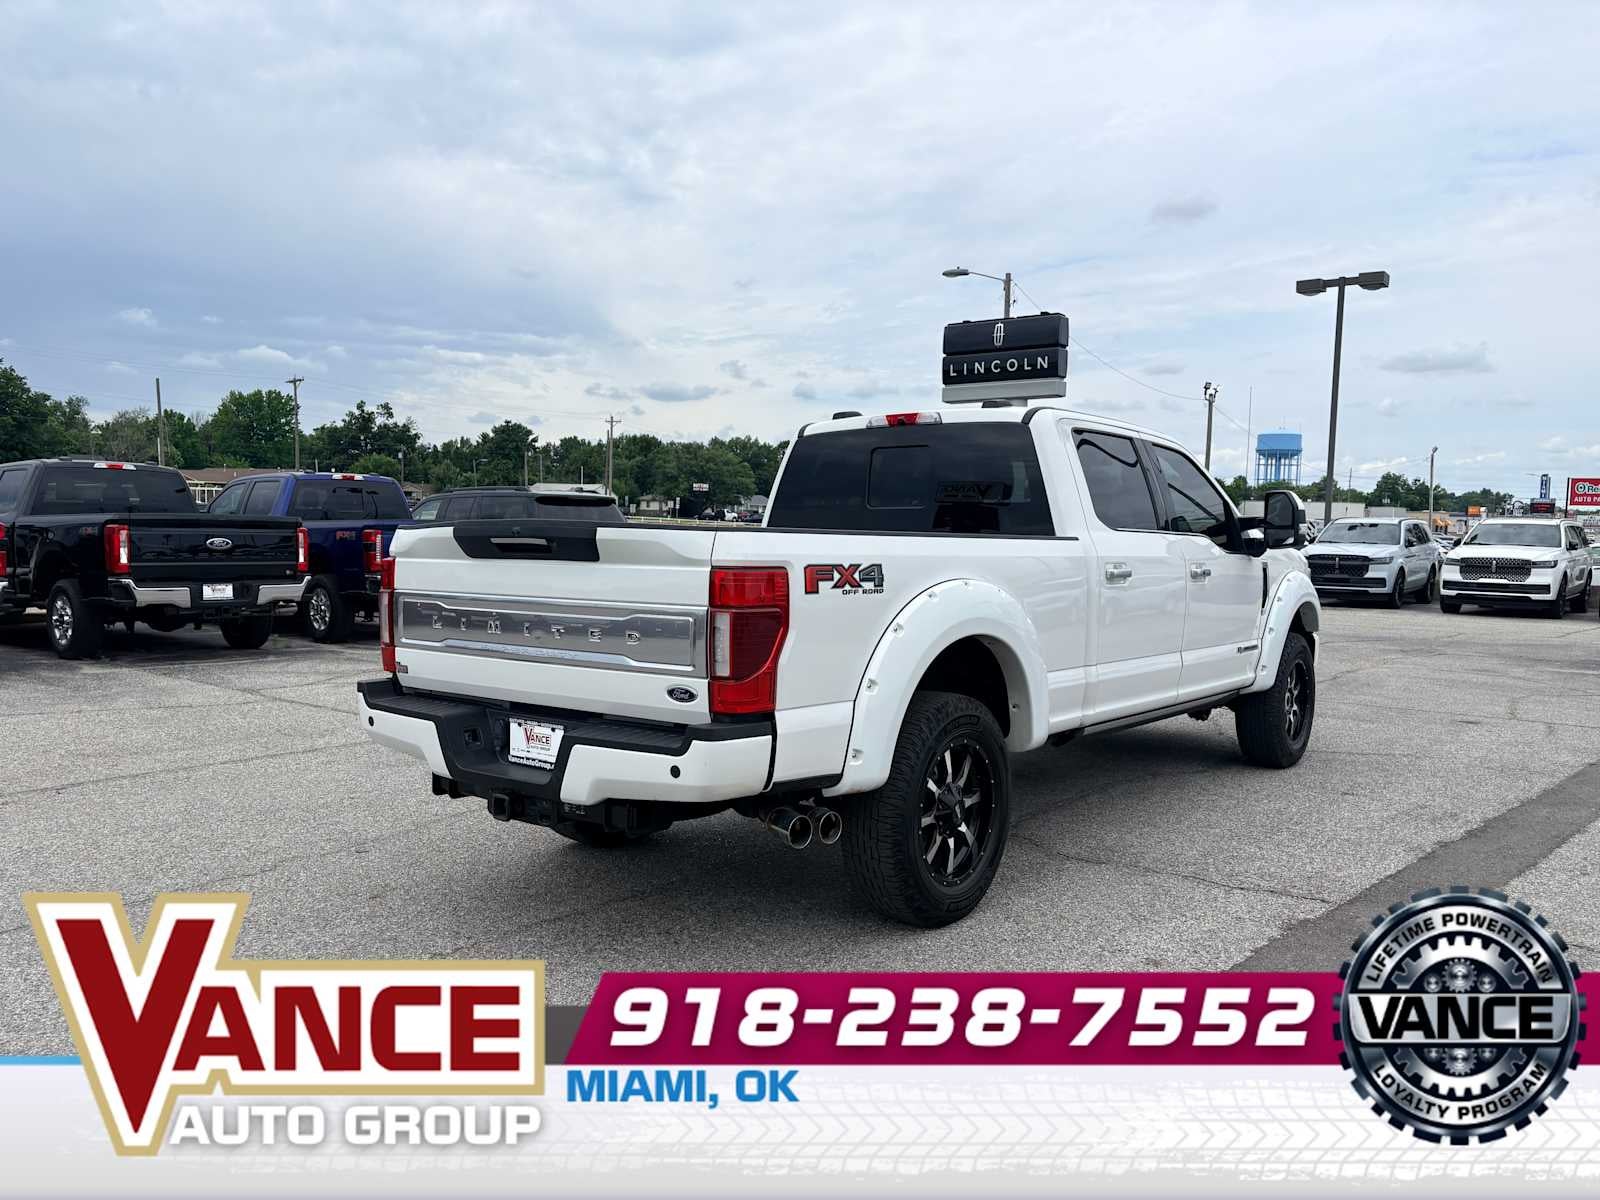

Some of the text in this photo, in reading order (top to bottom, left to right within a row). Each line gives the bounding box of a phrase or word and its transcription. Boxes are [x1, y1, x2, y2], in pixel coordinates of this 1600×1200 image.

[949, 356, 1049, 377] LINCOLN
[803, 563, 885, 595] FX4
[431, 615, 642, 645] LIMITED
[672, 687, 690, 700] Ford
[524, 727, 551, 746] VANCE
